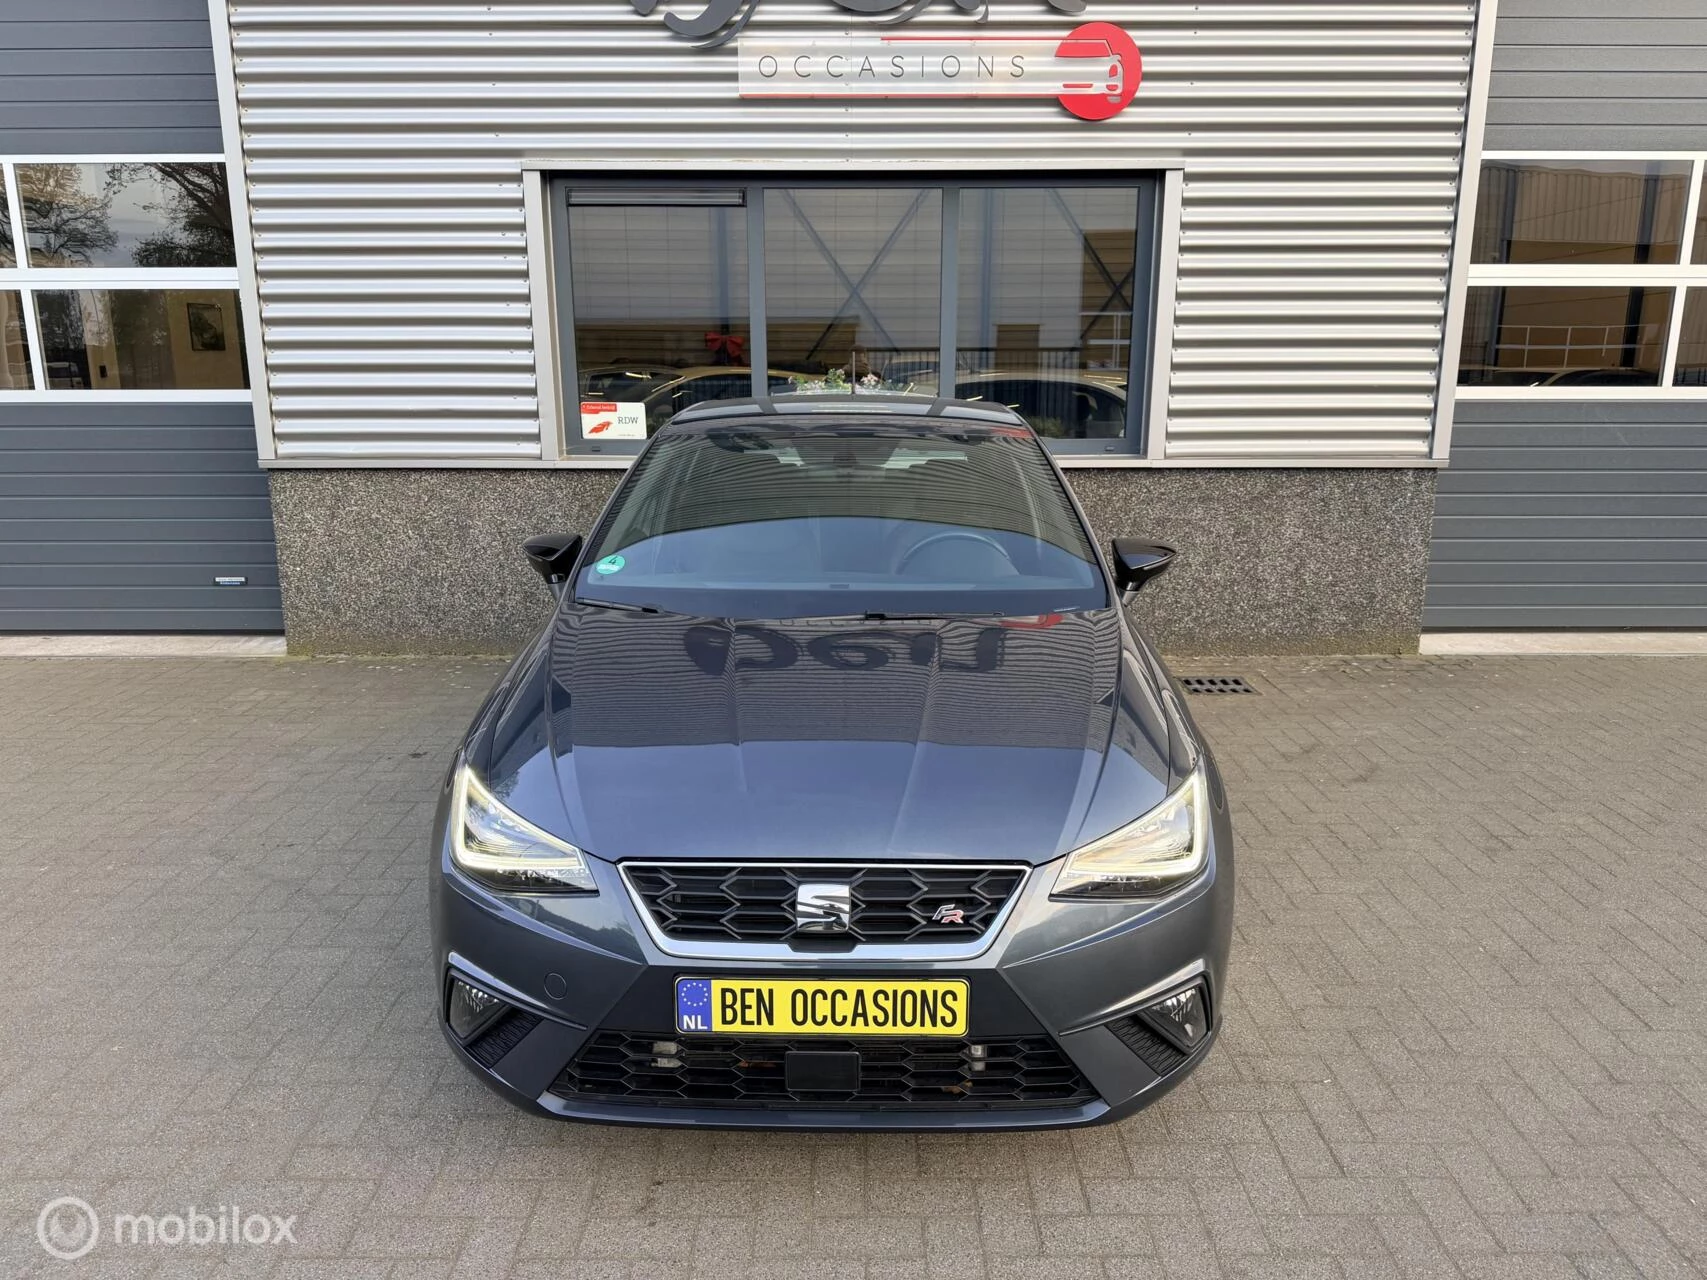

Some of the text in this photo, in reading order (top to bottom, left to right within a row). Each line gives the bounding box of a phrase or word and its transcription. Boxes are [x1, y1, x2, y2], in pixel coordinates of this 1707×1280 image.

[758, 55, 1026, 78] OCCASIONS
[617, 416, 639, 425] RDW
[608, 555, 618, 565] 4
[931, 903, 964, 924] FR
[682, 987, 959, 1030] NL BEN OCCASIONS
